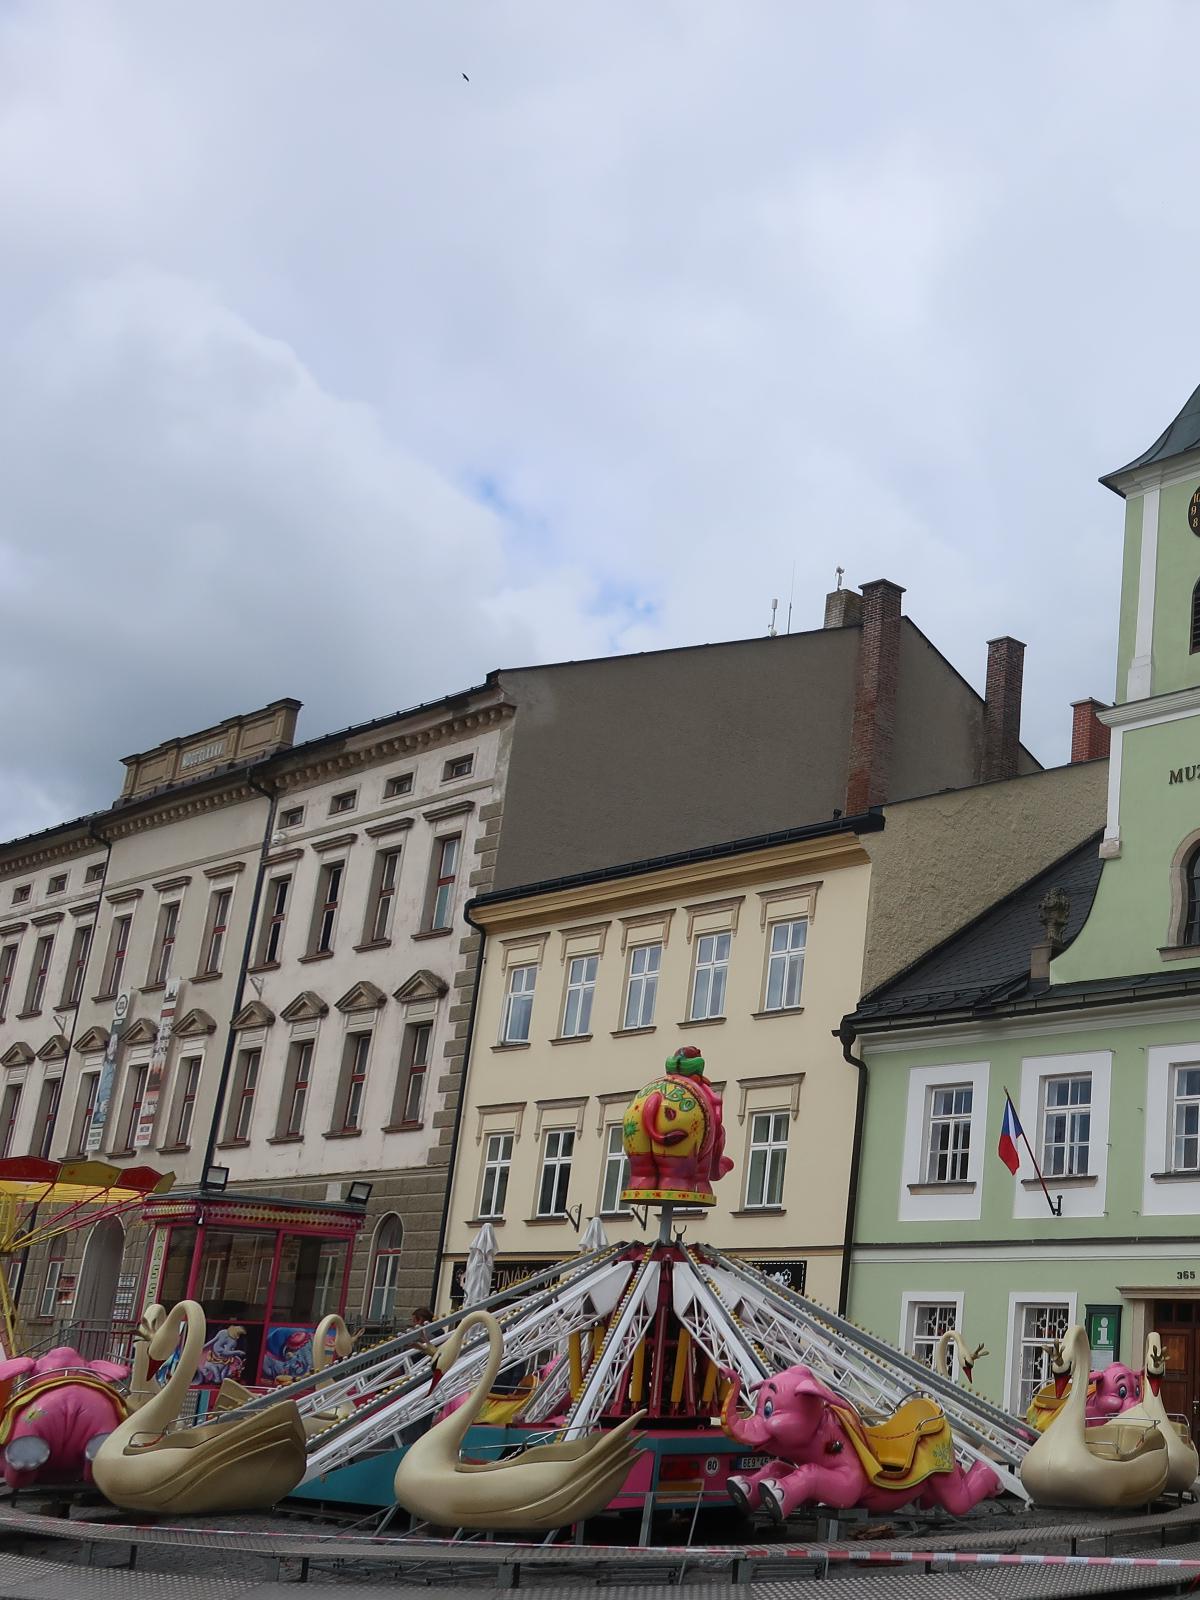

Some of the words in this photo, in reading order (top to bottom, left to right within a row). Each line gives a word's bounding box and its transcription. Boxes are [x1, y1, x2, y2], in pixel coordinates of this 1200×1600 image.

[1191, 505, 1197, 515] 9
[1192, 518, 1198, 528] 8
[1177, 1270, 1196, 1280] 365
[707, 1460, 718, 1471] 80
